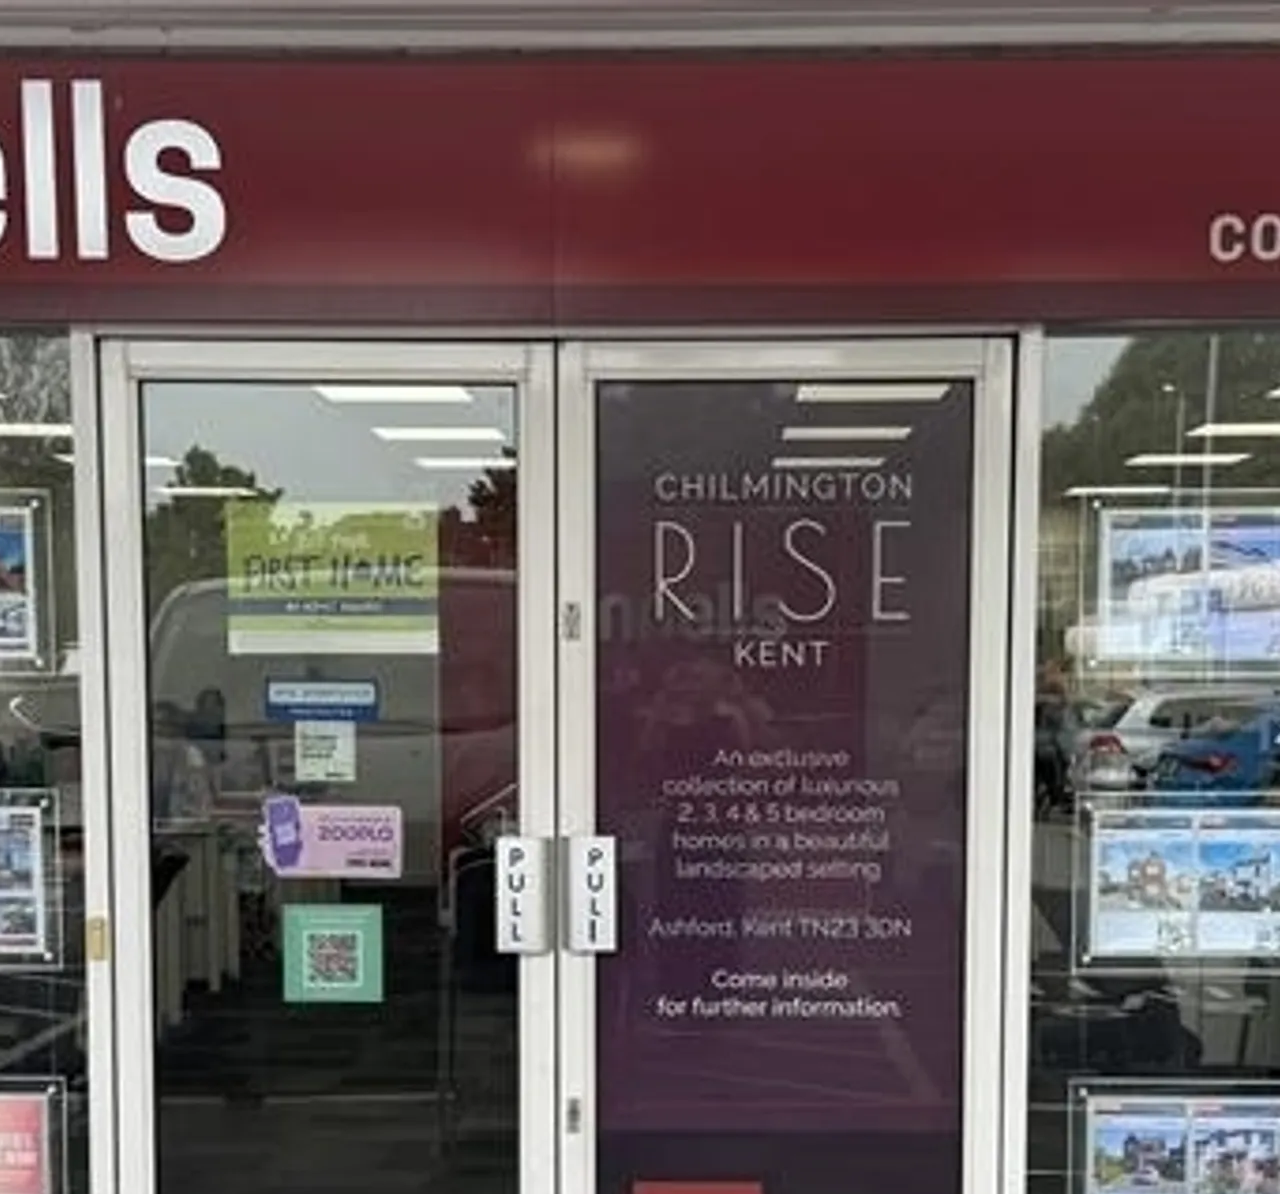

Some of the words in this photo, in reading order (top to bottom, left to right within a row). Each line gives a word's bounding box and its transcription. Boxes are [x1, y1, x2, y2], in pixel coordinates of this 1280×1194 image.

[654, 471, 912, 500] CHILMINGTON
[654, 517, 912, 621] RISE
[733, 640, 830, 667] KENT
[713, 749, 744, 768] An
[748, 748, 851, 769] exclusive
[662, 775, 769, 797] collection
[772, 775, 796, 797] of
[726, 803, 740, 822] 4
[744, 803, 760, 823] &
[766, 803, 780, 822] 5
[785, 802, 885, 823] bedroom
[673, 830, 746, 850] homes
[793, 830, 890, 851] beautiful
[676, 857, 802, 881] landscaped
[507, 847, 526, 943] PULL
[741, 917, 792, 938] Kent
[799, 917, 859, 938] TN23
[710, 968, 777, 990] Come
[782, 968, 849, 990] inside
[657, 996, 686, 1016] for
[692, 996, 766, 1016] further
